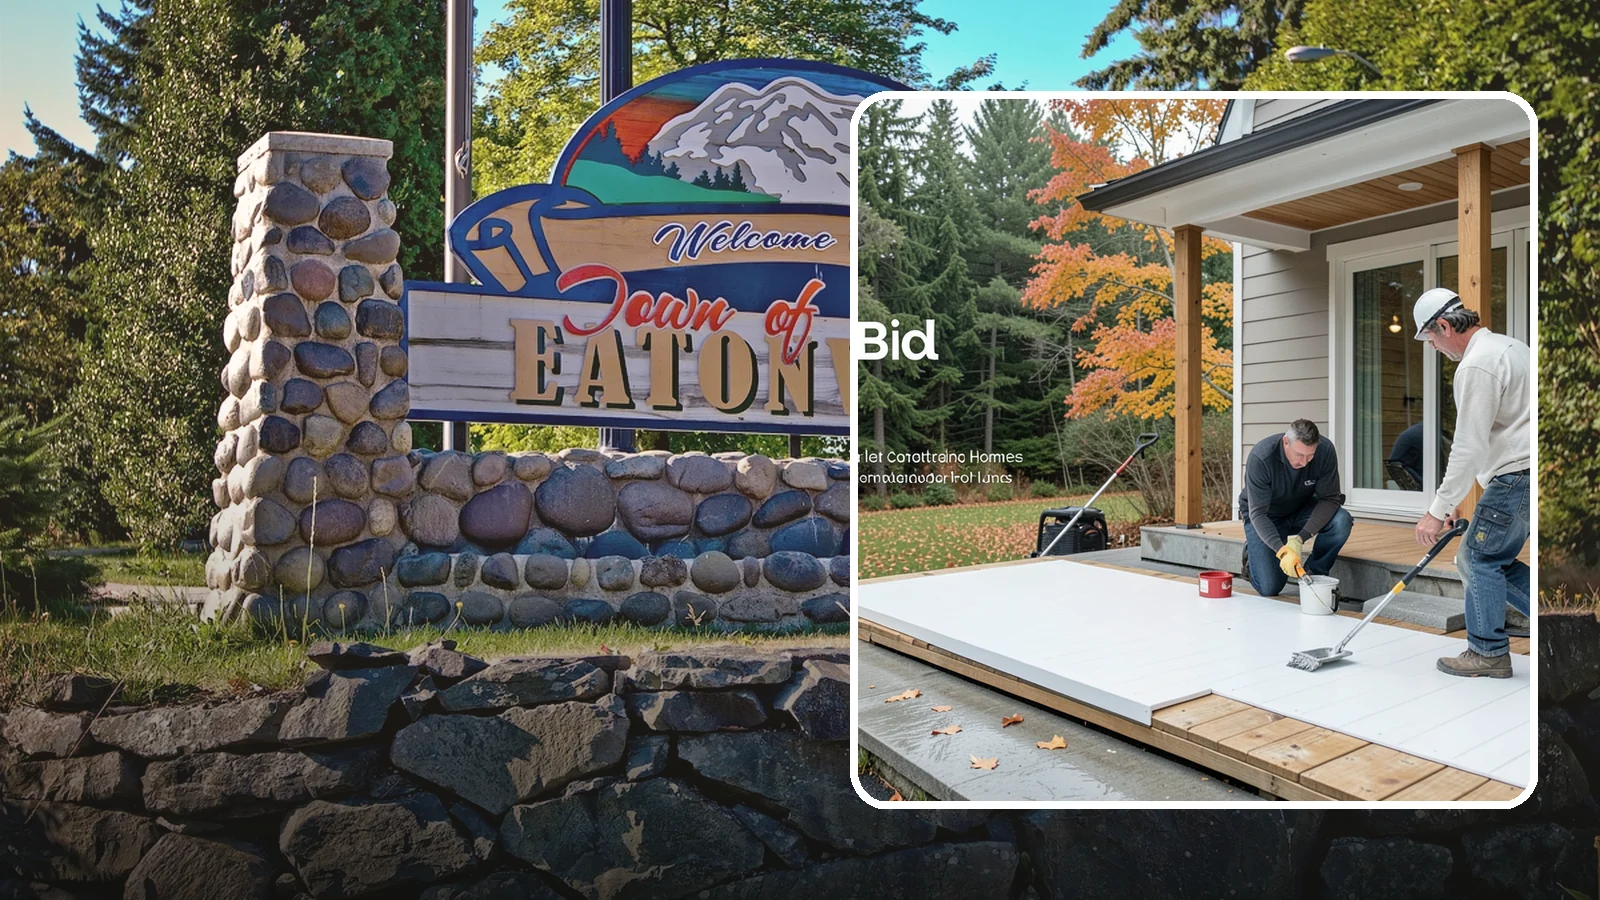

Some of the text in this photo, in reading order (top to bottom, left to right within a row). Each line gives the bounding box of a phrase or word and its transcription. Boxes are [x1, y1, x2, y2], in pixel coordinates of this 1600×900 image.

[653, 220, 837, 263] Welcome
[556, 263, 826, 365] Town of
